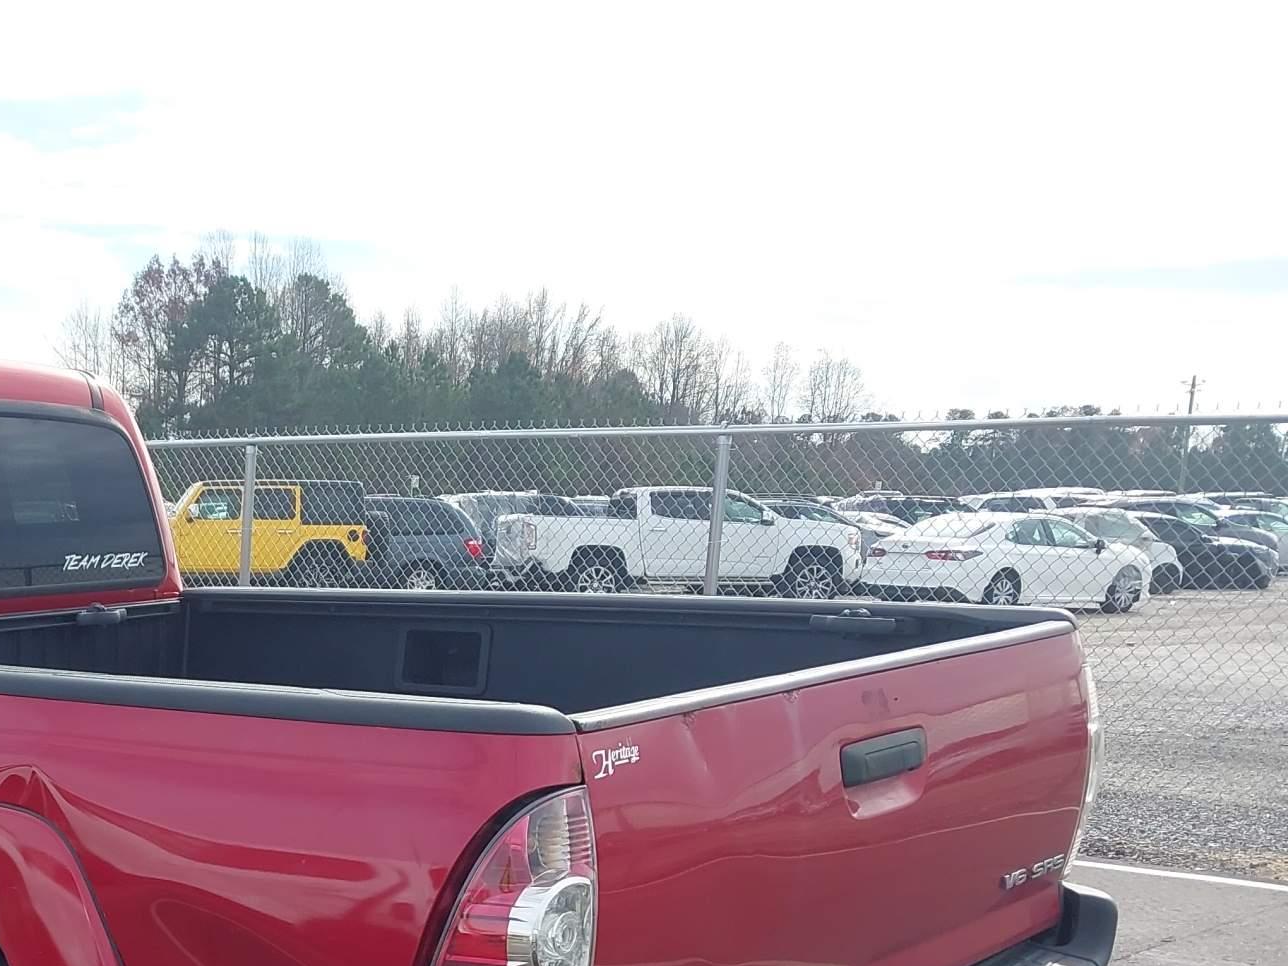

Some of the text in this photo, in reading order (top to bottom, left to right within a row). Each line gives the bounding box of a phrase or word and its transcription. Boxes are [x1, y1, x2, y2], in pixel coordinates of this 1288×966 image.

[62, 551, 148, 572] TEAM DEREK
[592, 742, 640, 779] Heritage
[1001, 867, 1027, 890] V6
